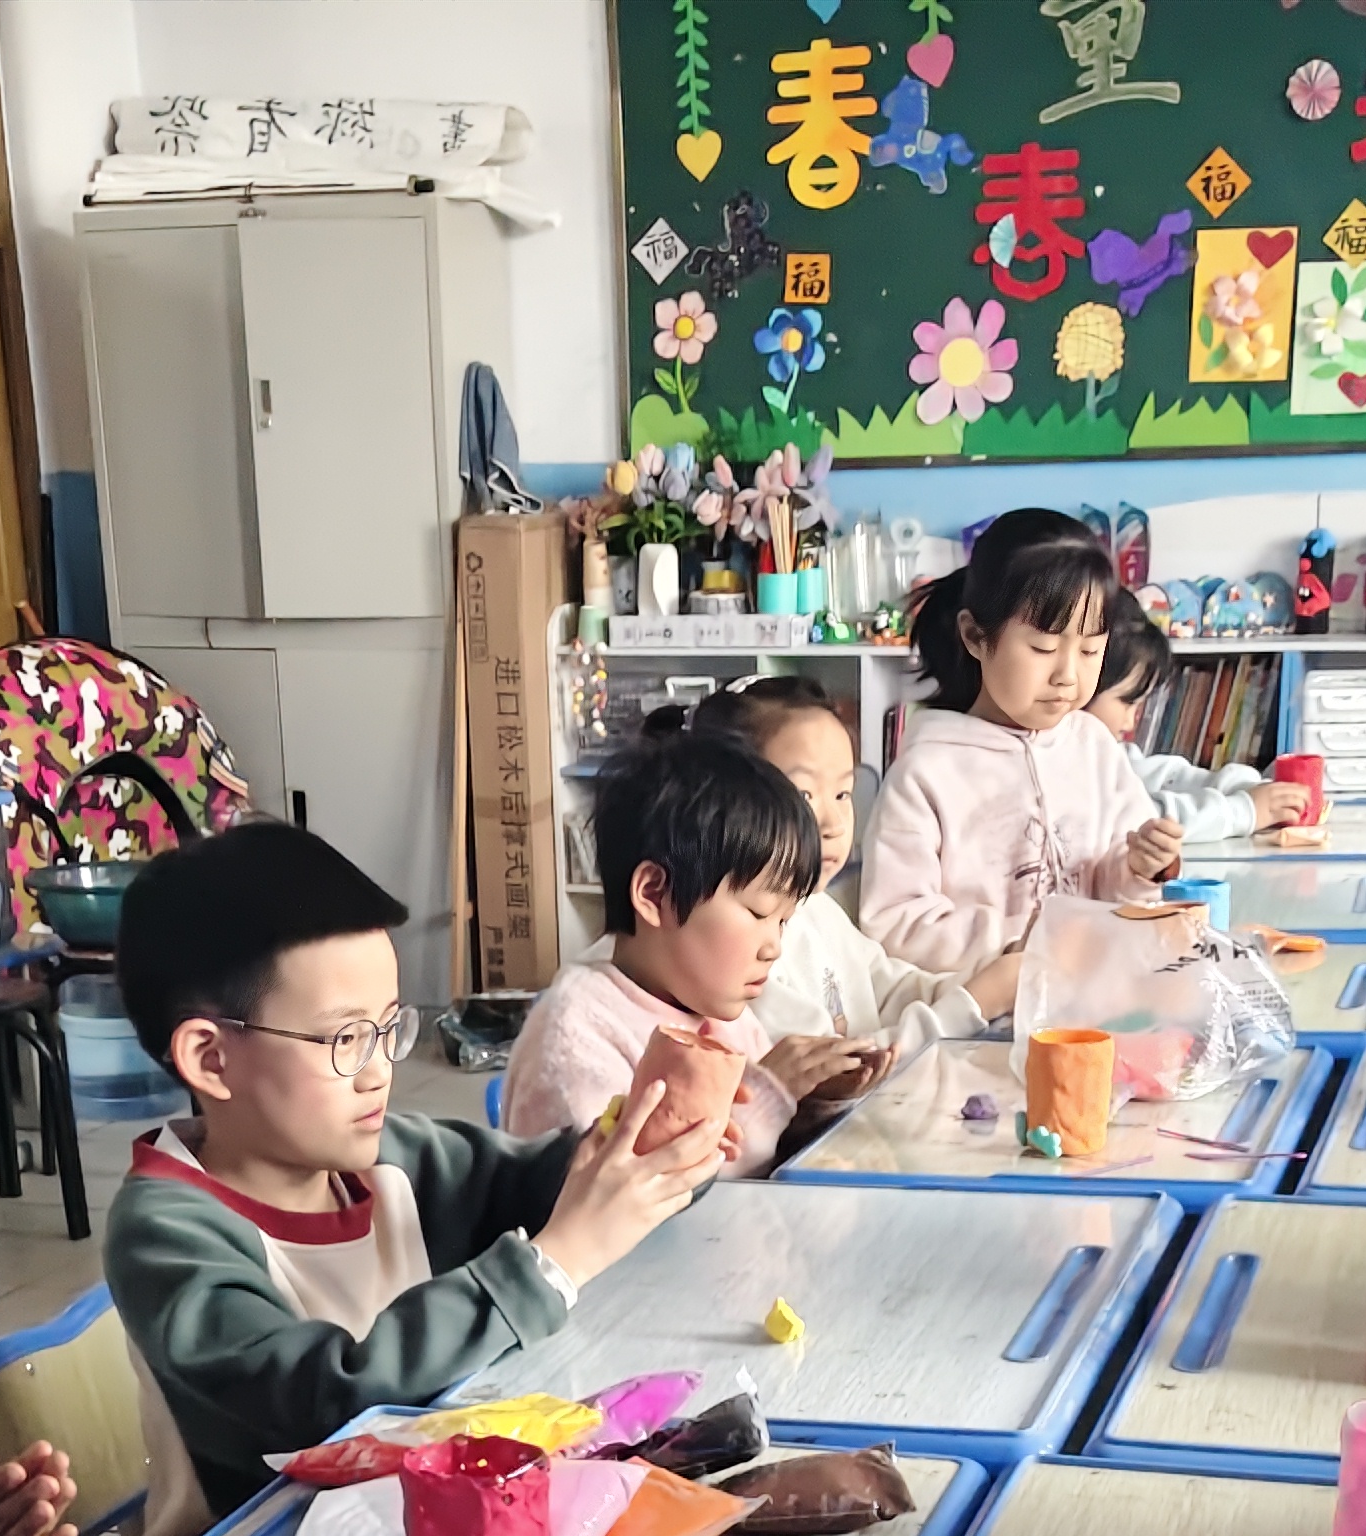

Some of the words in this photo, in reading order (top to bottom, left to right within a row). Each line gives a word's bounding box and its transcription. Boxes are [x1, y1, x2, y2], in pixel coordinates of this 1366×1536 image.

[766, 38, 879, 209] 春
[975, 142, 1086, 302] 春
[1201, 164, 1237, 202] 福
[790, 262, 825, 299] 福
